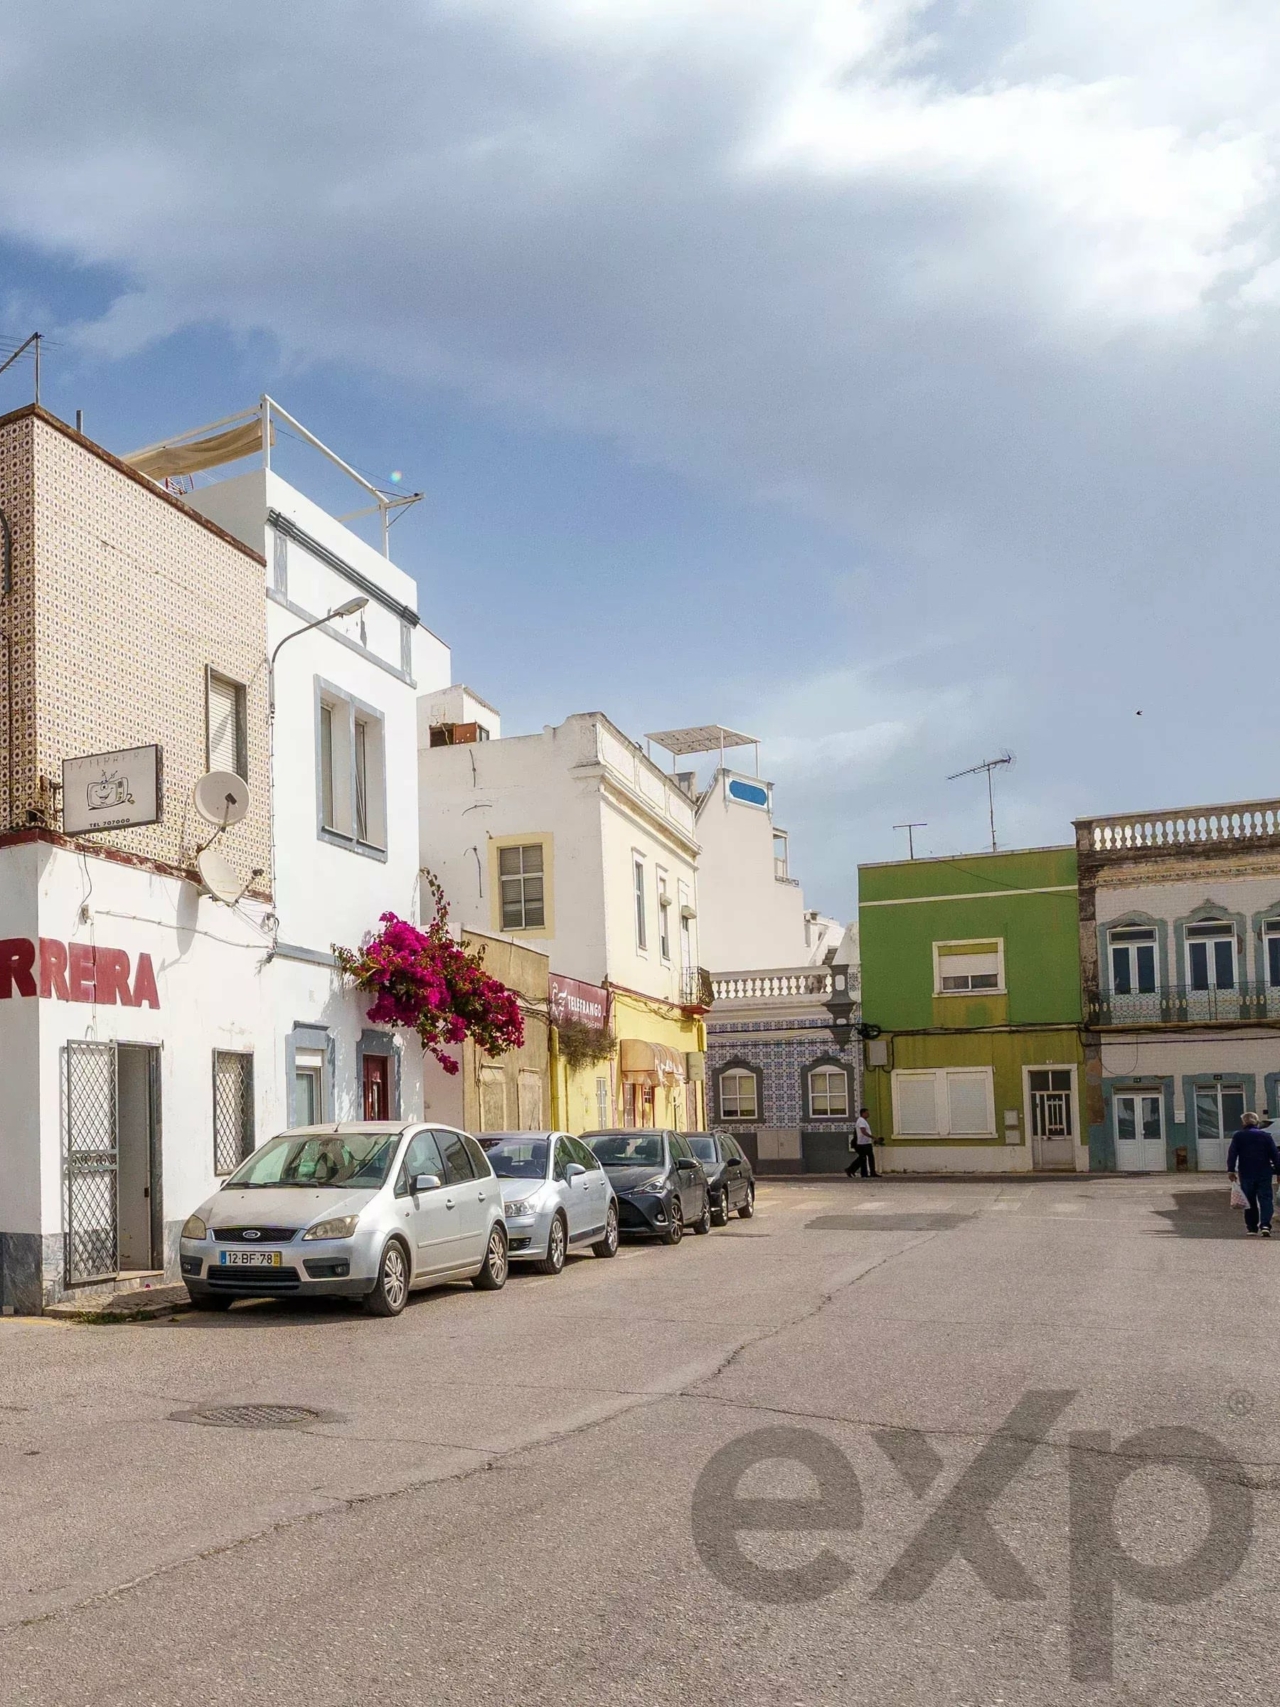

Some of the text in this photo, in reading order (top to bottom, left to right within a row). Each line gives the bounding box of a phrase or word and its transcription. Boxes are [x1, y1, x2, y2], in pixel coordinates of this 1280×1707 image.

[103, 818, 131, 826] 707000
[567, 995, 602, 1017] TELEFRANGO
[228, 1253, 273, 1265] 12-BF-78
